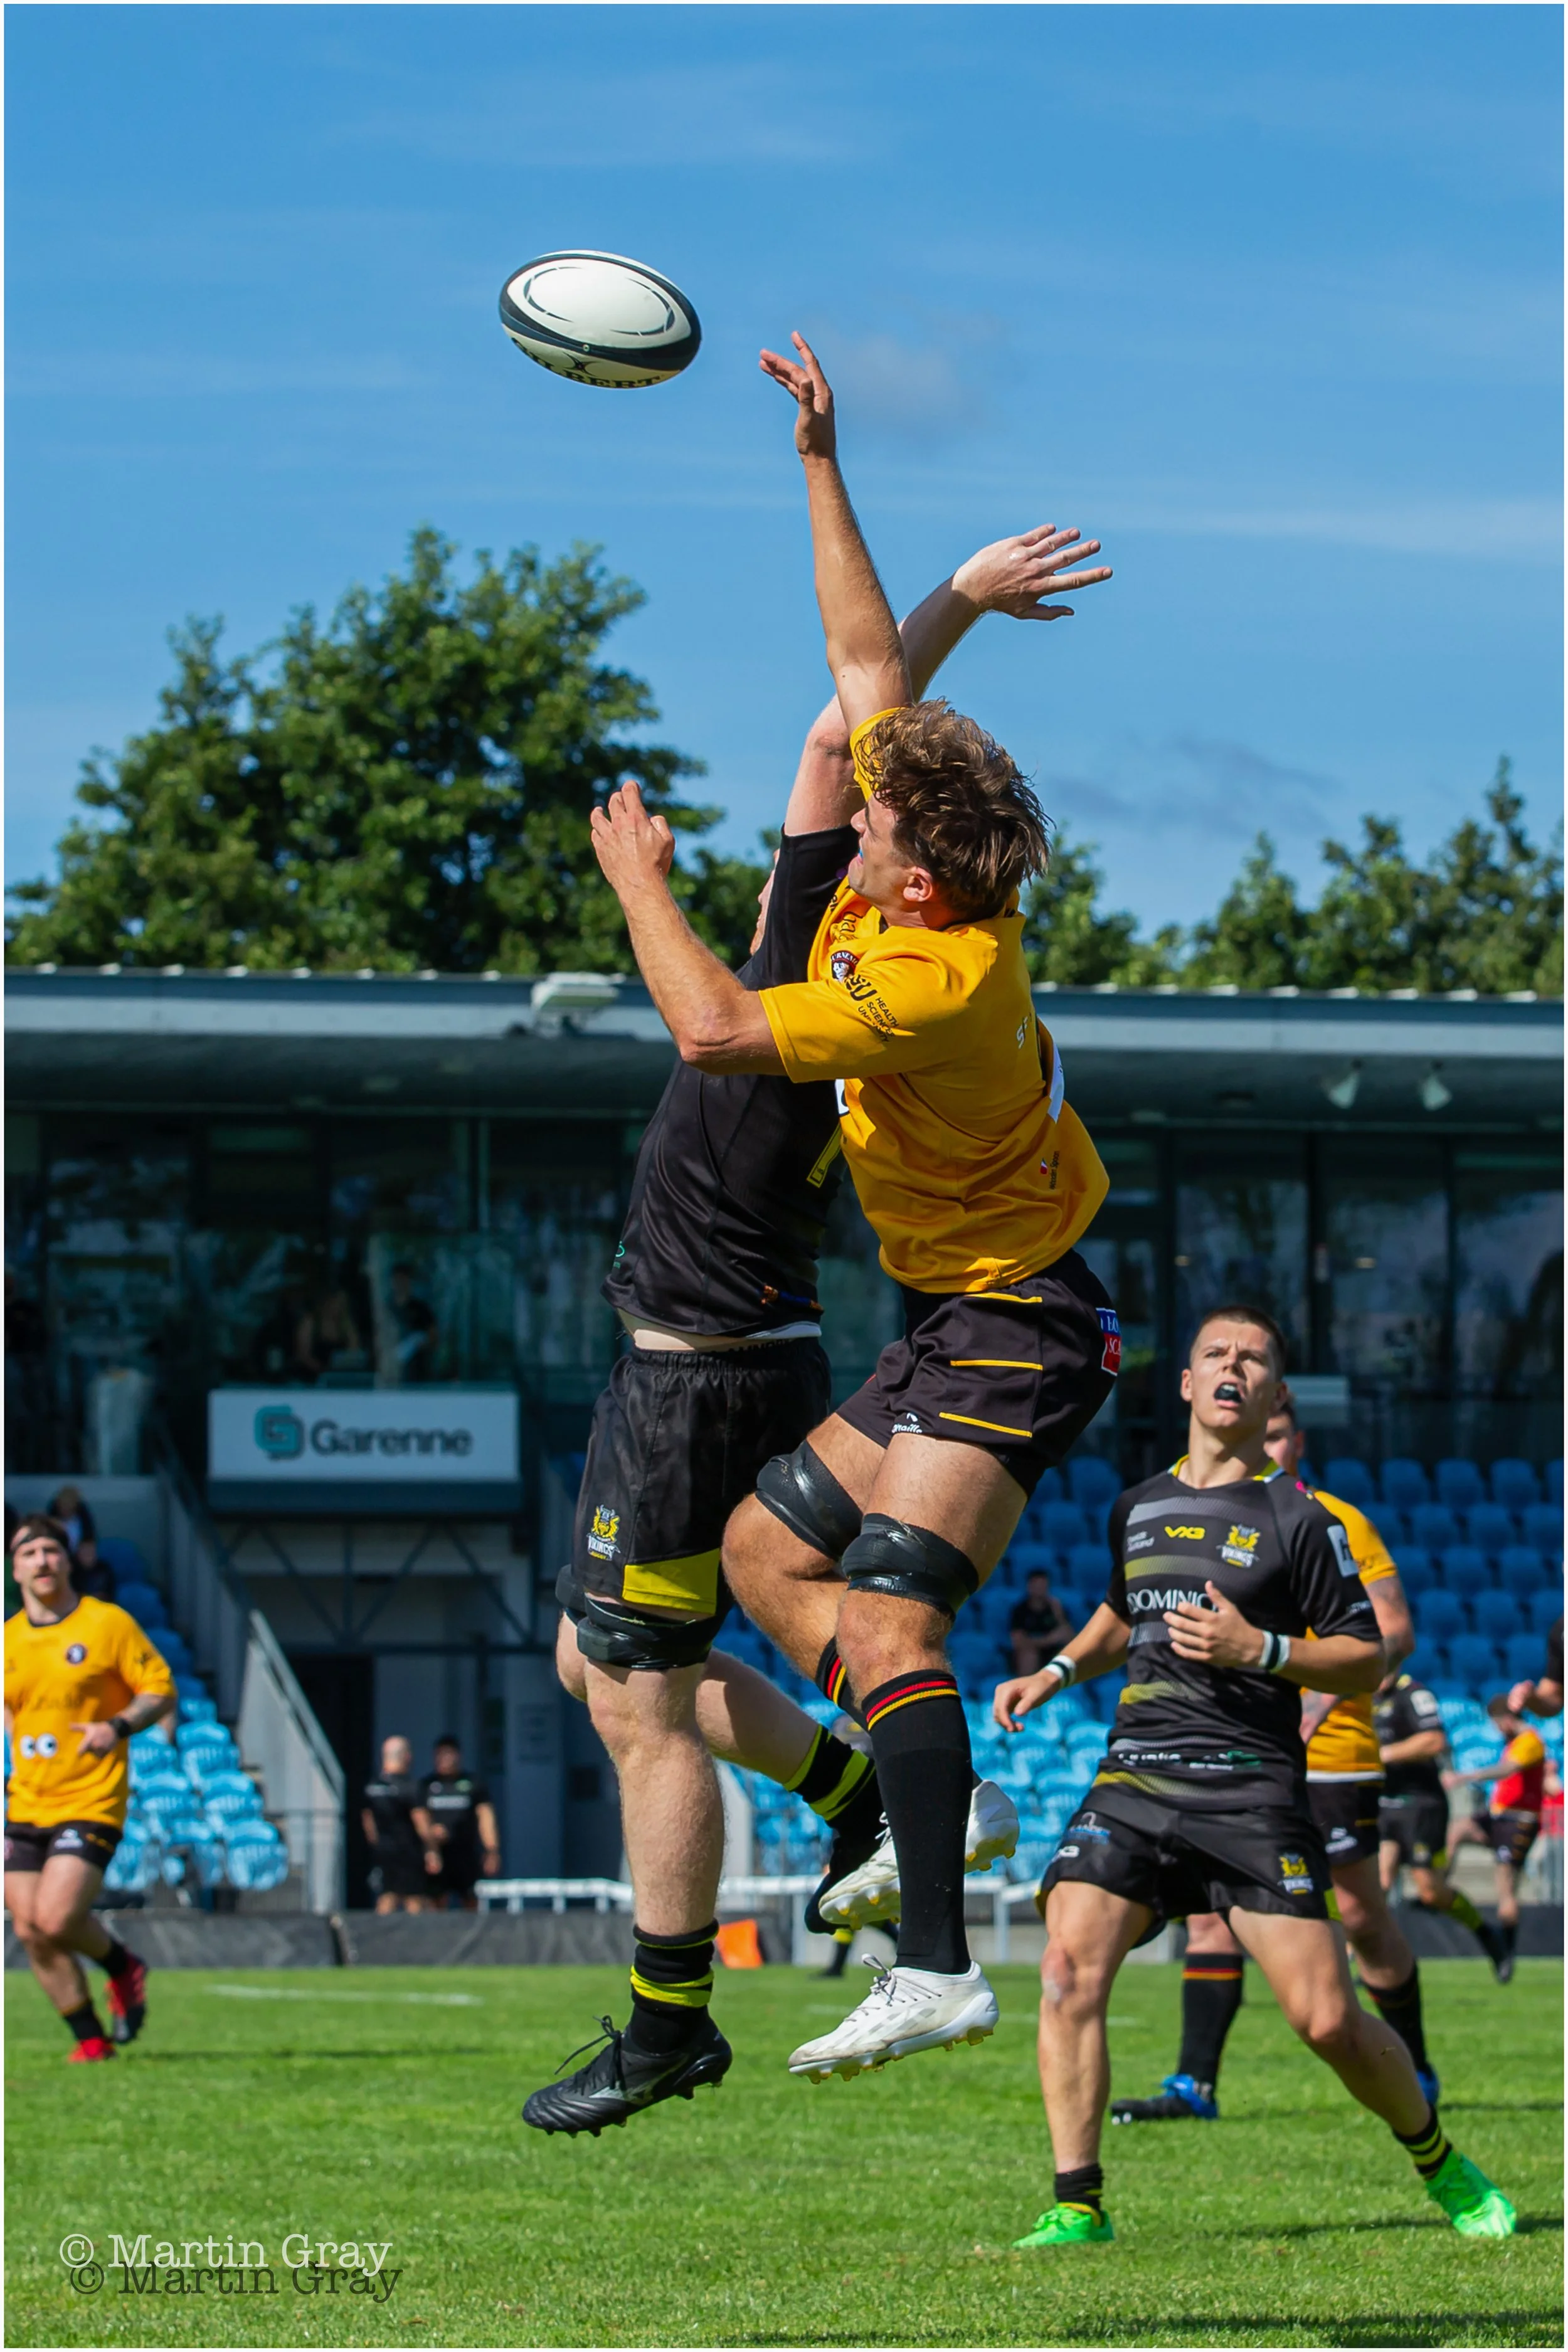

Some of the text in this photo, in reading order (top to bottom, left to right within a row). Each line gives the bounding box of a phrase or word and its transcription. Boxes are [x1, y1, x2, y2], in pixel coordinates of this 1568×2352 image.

[845, 974, 878, 1002] SU
[875, 997, 900, 1027] HEALTH
[310, 1419, 474, 1456] Garenne
[1164, 1525, 1205, 1540] VX3
